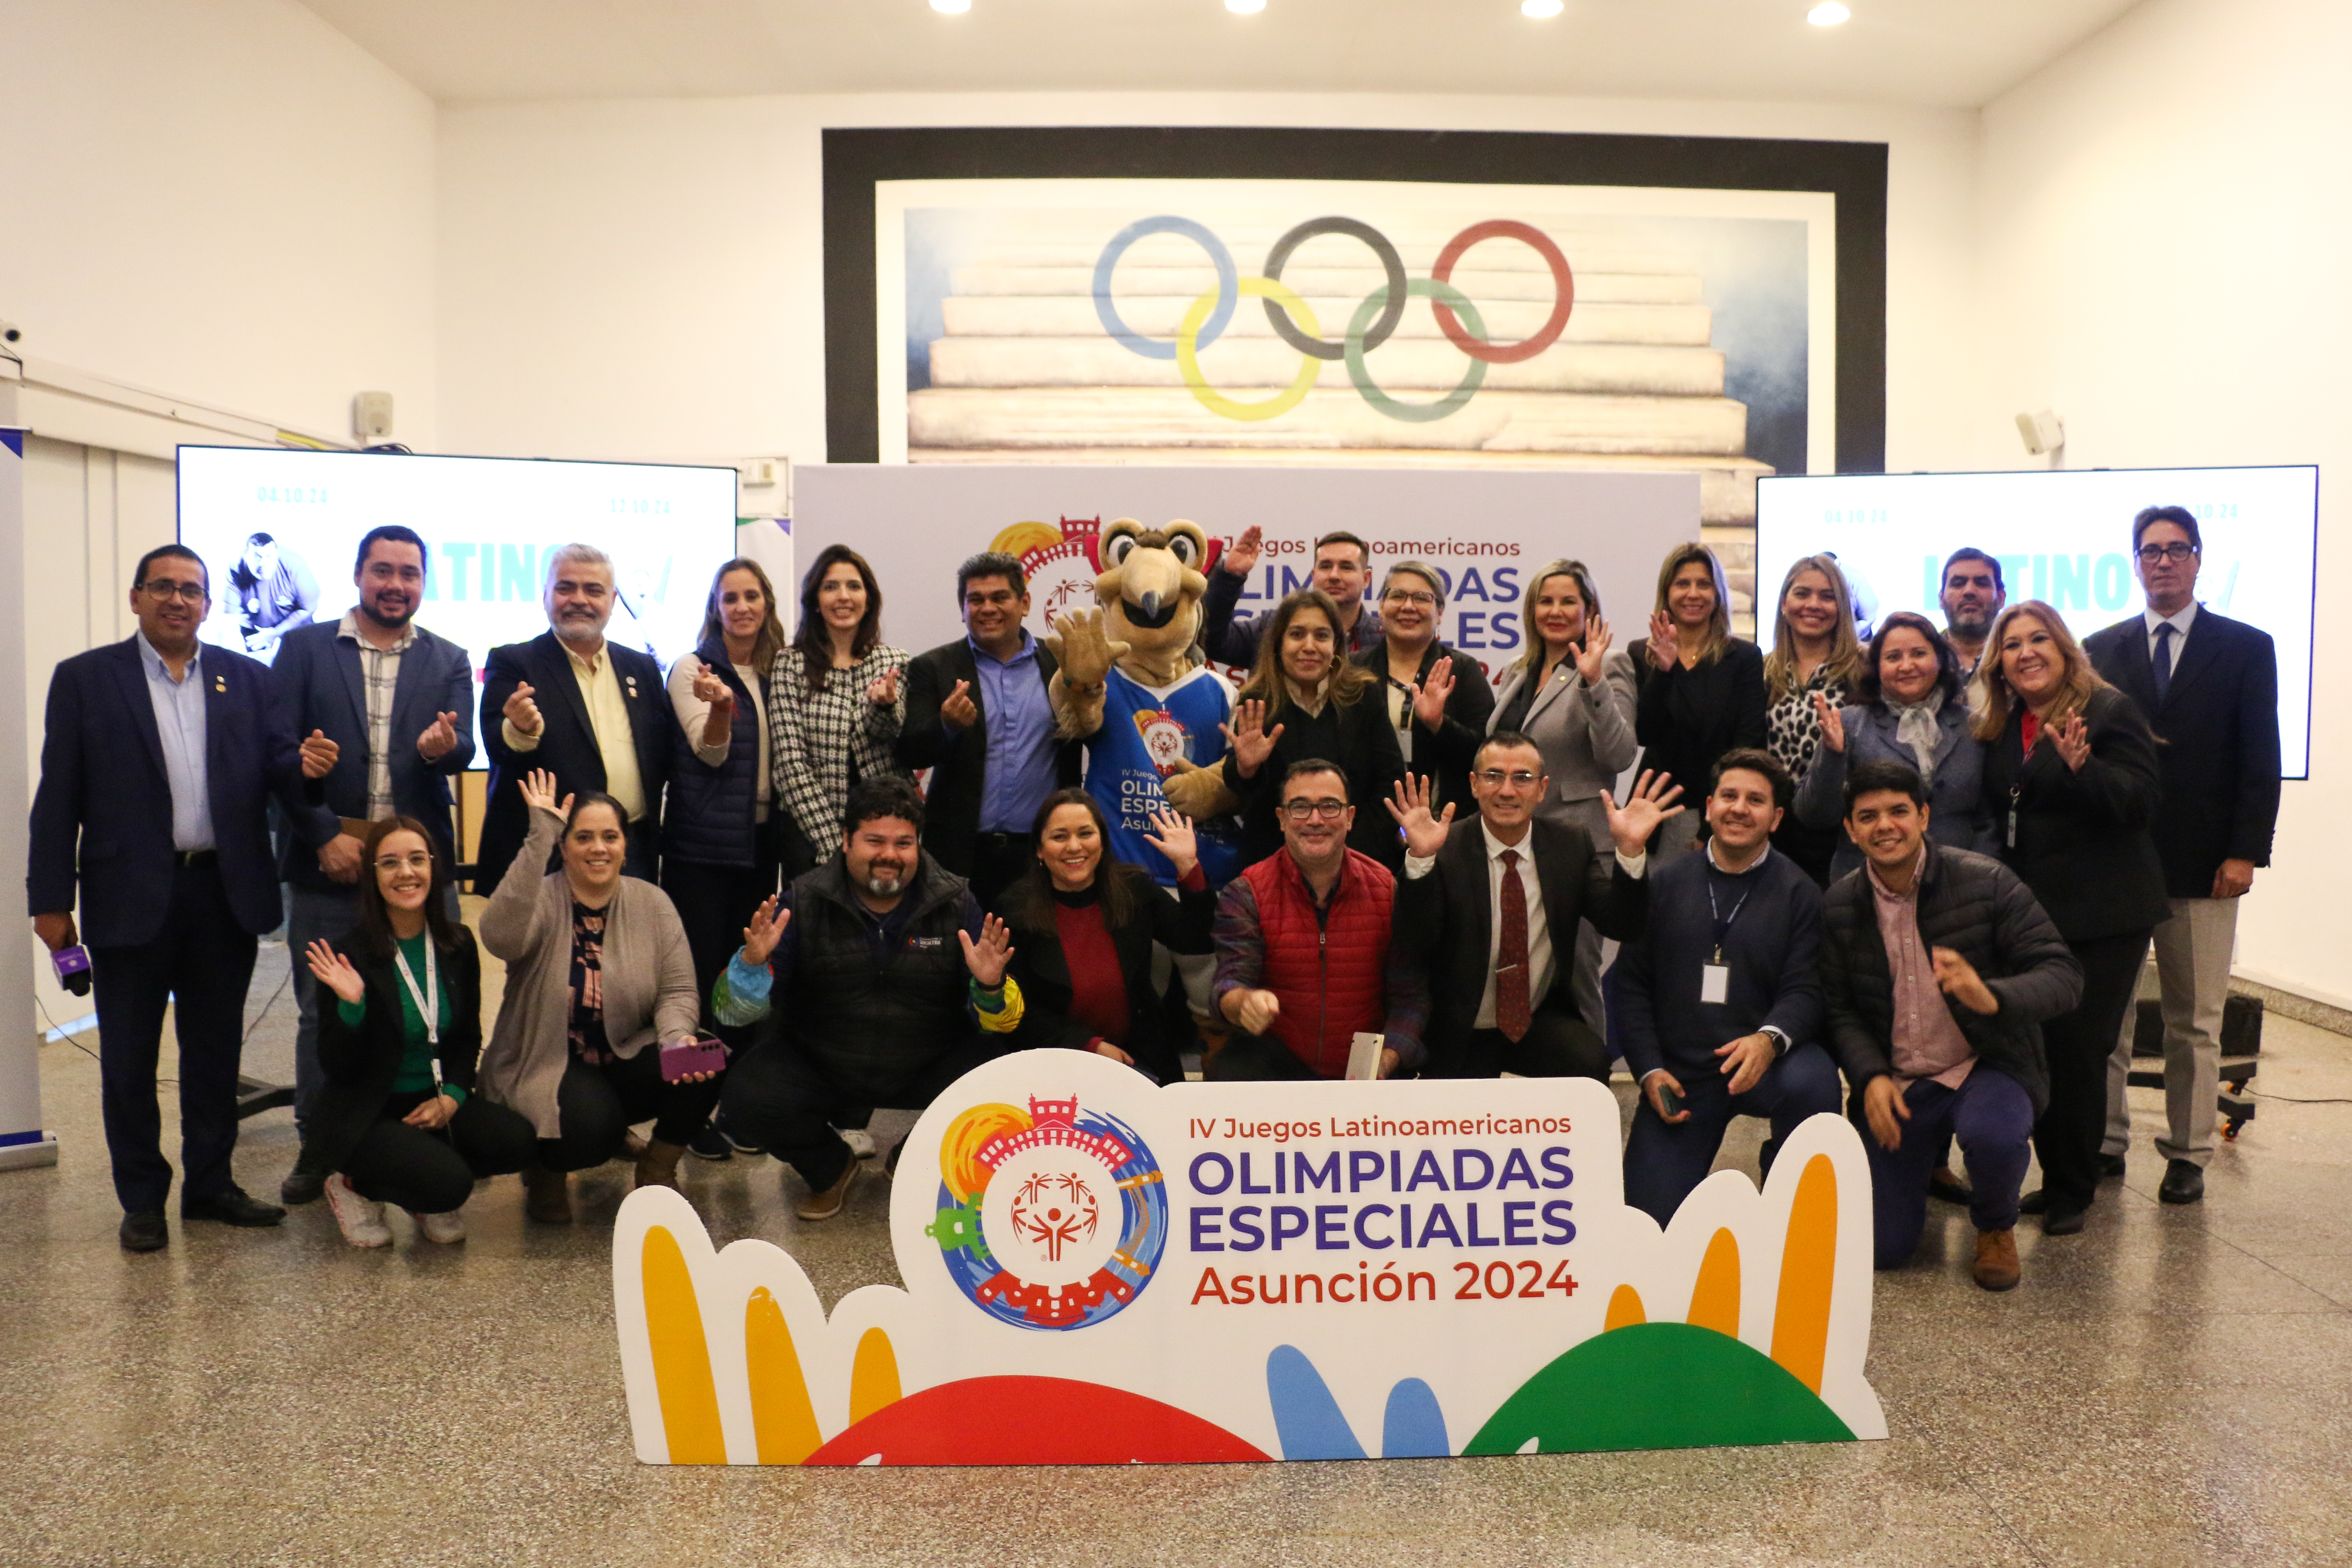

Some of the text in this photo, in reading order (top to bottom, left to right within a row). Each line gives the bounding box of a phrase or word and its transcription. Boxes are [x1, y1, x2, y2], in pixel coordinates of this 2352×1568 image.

[1923, 553, 2131, 611] LTINO
[1133, 769, 1157, 780] Juego
[1190, 1115, 1572, 1143] IV Juegos Latinoamericanos
[1189, 1147, 1574, 1195] OLIMPIADAS
[1190, 1200, 1576, 1252] ESPECIALES
[1190, 1259, 1579, 1306] Asunción 2024
